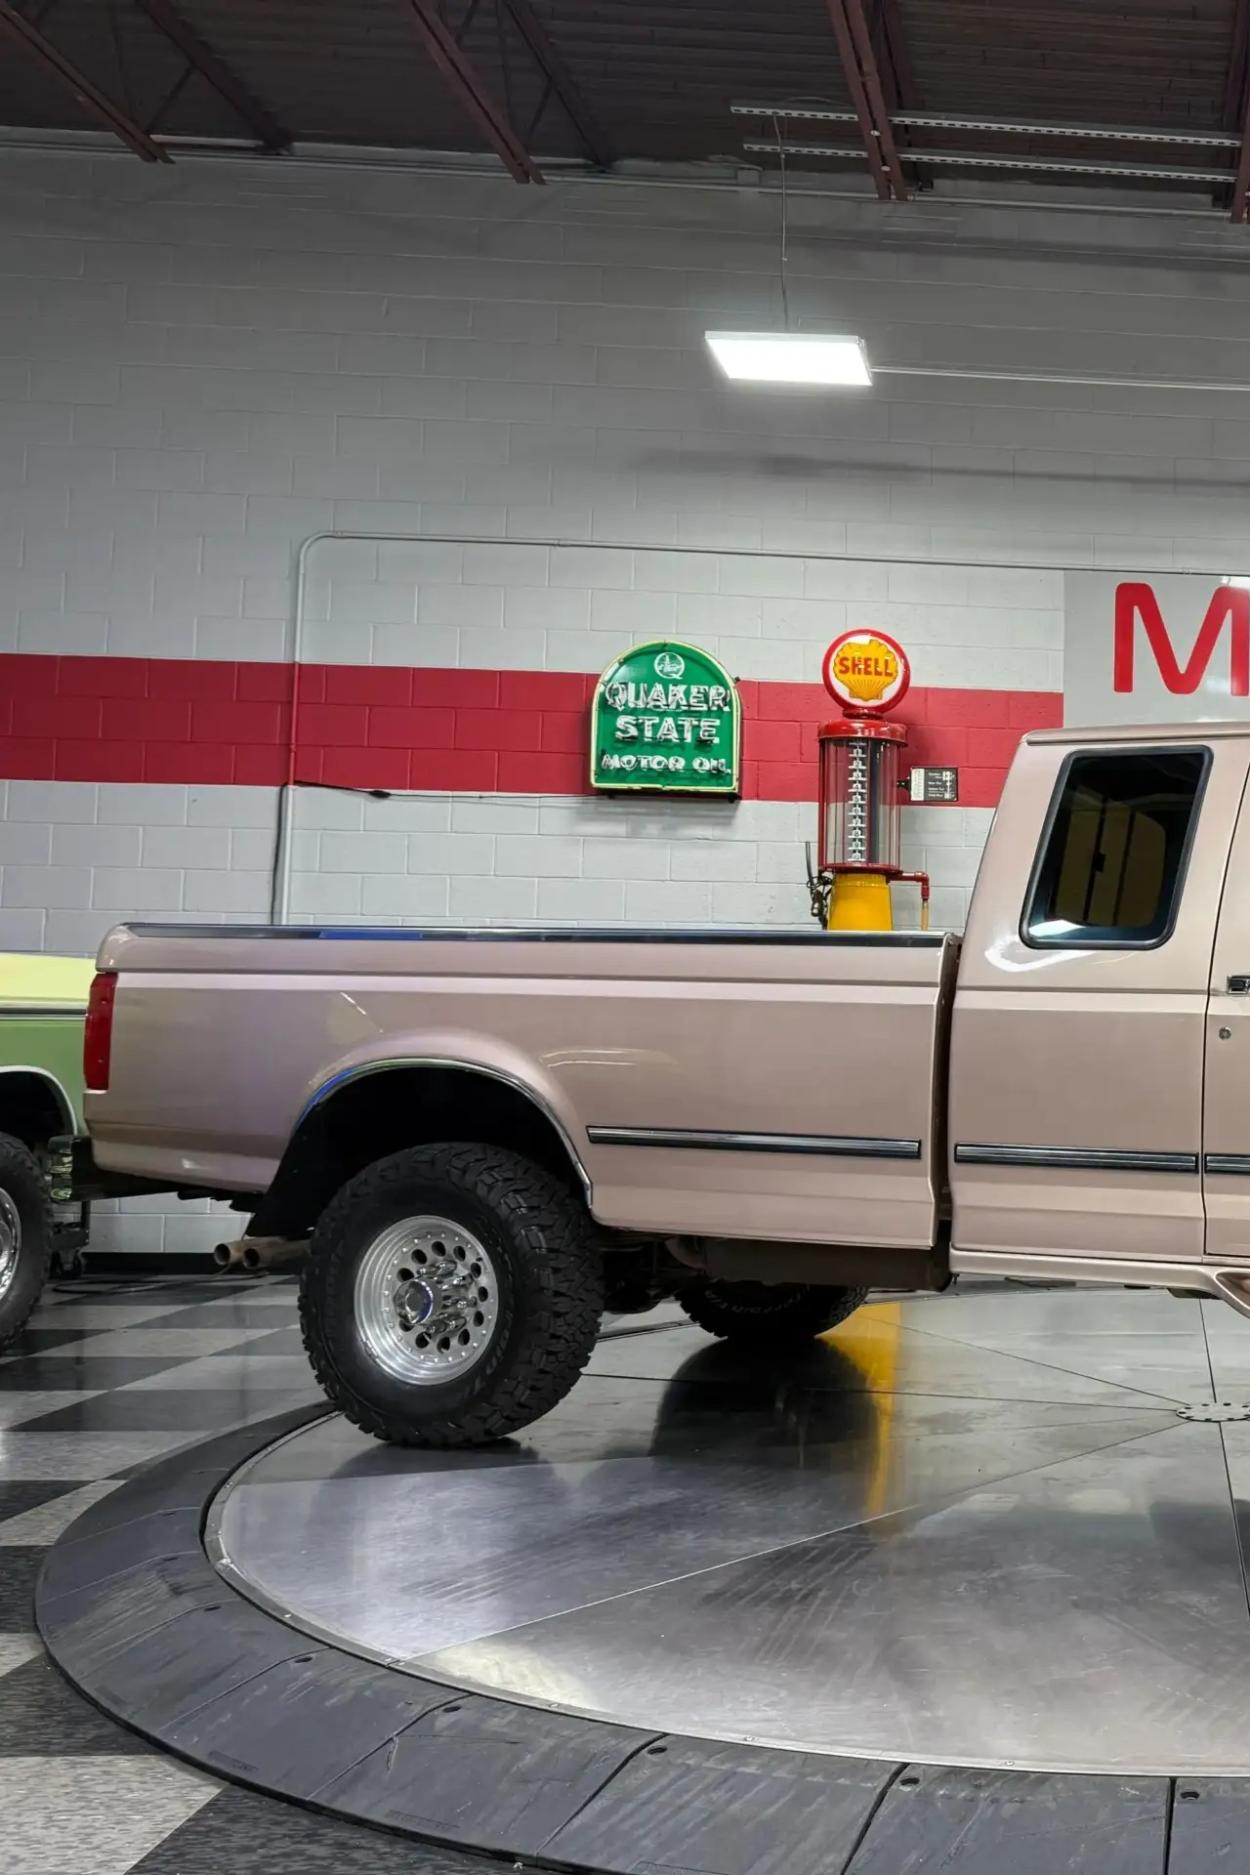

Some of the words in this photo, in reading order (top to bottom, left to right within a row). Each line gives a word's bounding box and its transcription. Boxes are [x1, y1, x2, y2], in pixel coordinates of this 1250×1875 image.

[838, 656, 893, 677] SHELL
[605, 681, 730, 711] QUAKER
[615, 715, 720, 744] STATE
[601, 754, 686, 772] MOTOR
